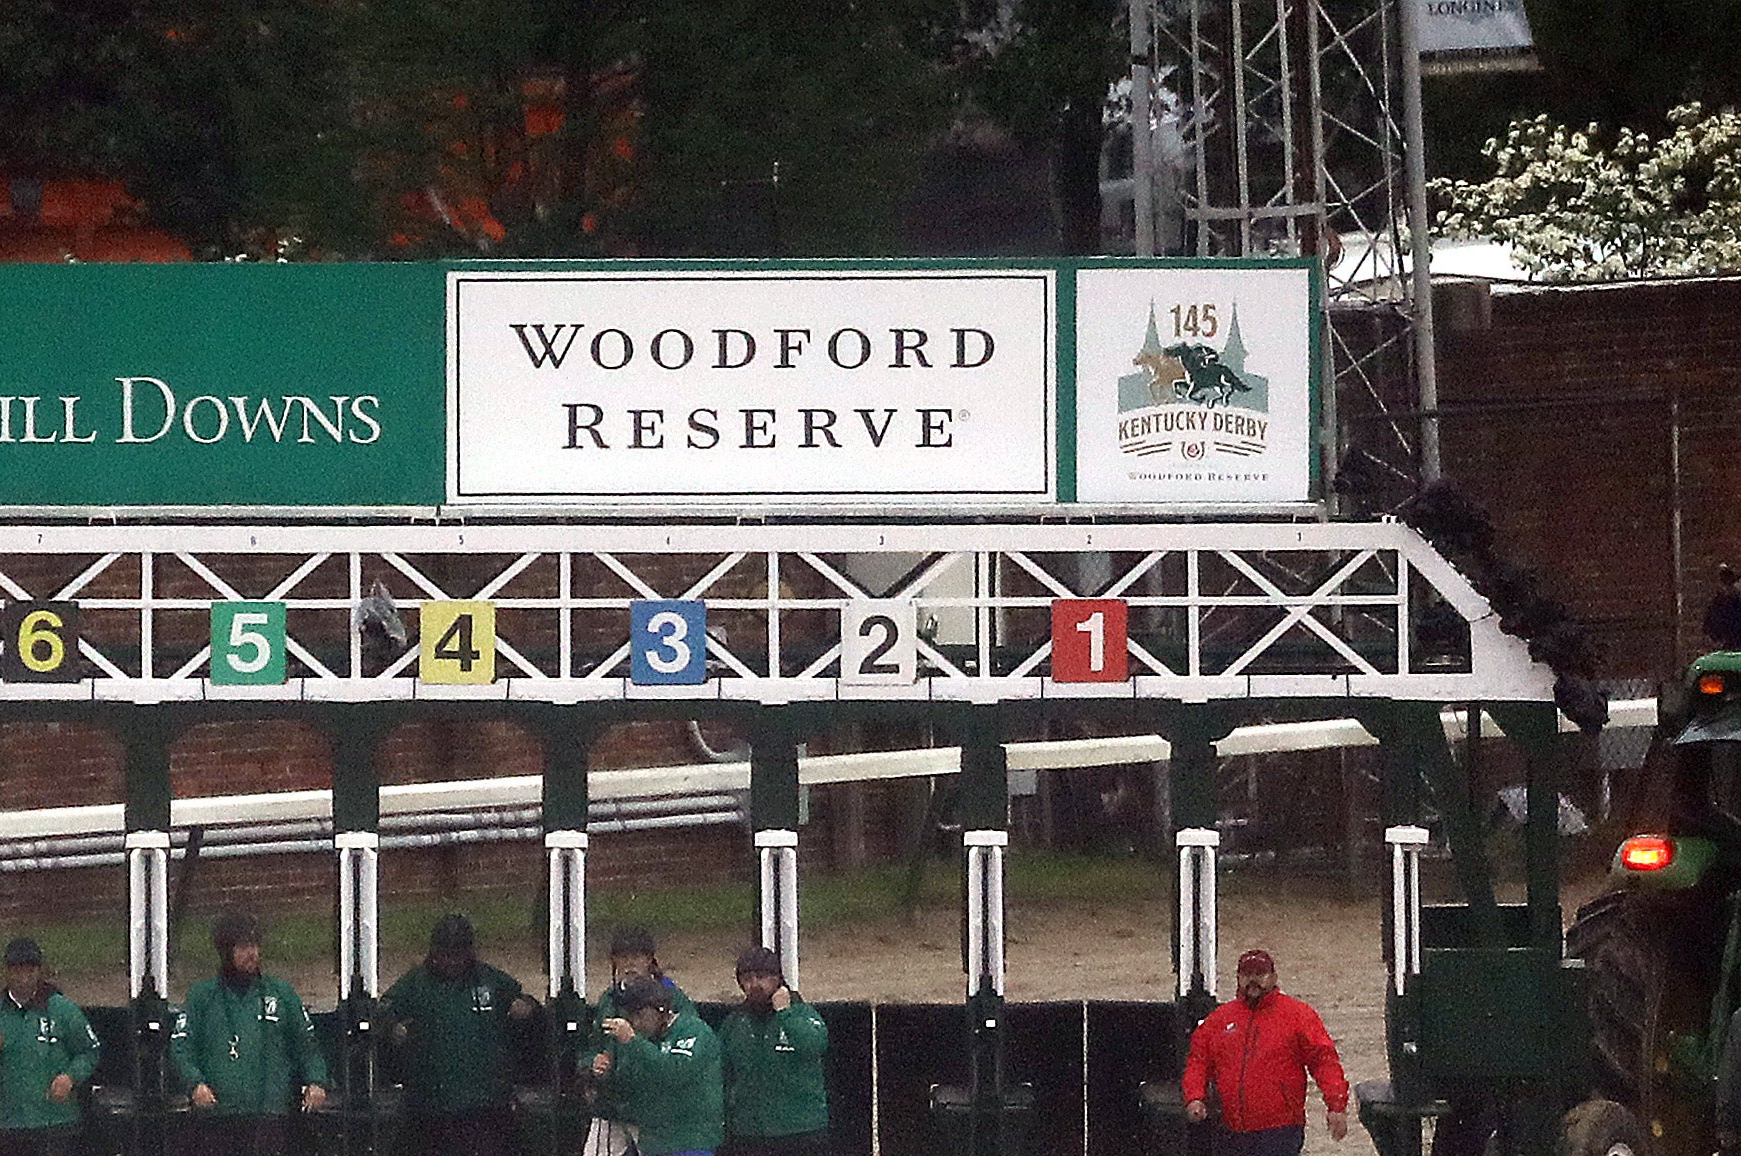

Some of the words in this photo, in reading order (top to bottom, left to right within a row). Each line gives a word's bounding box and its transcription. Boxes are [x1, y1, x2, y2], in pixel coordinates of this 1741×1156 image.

[509, 323, 995, 370] WOODFORD
[1169, 303, 1218, 338] 145
[115, 376, 381, 443] DOWNS
[1118, 411, 1208, 441] KENTUCKY
[1212, 412, 1269, 440] DERBY
[37, 533, 43, 544] 7
[17, 610, 64, 672] 6
[226, 613, 271, 673] 5
[434, 614, 481, 672] 4
[645, 611, 691, 674] 3
[858, 615, 900, 675] 2
[1076, 612, 1104, 672] 1
